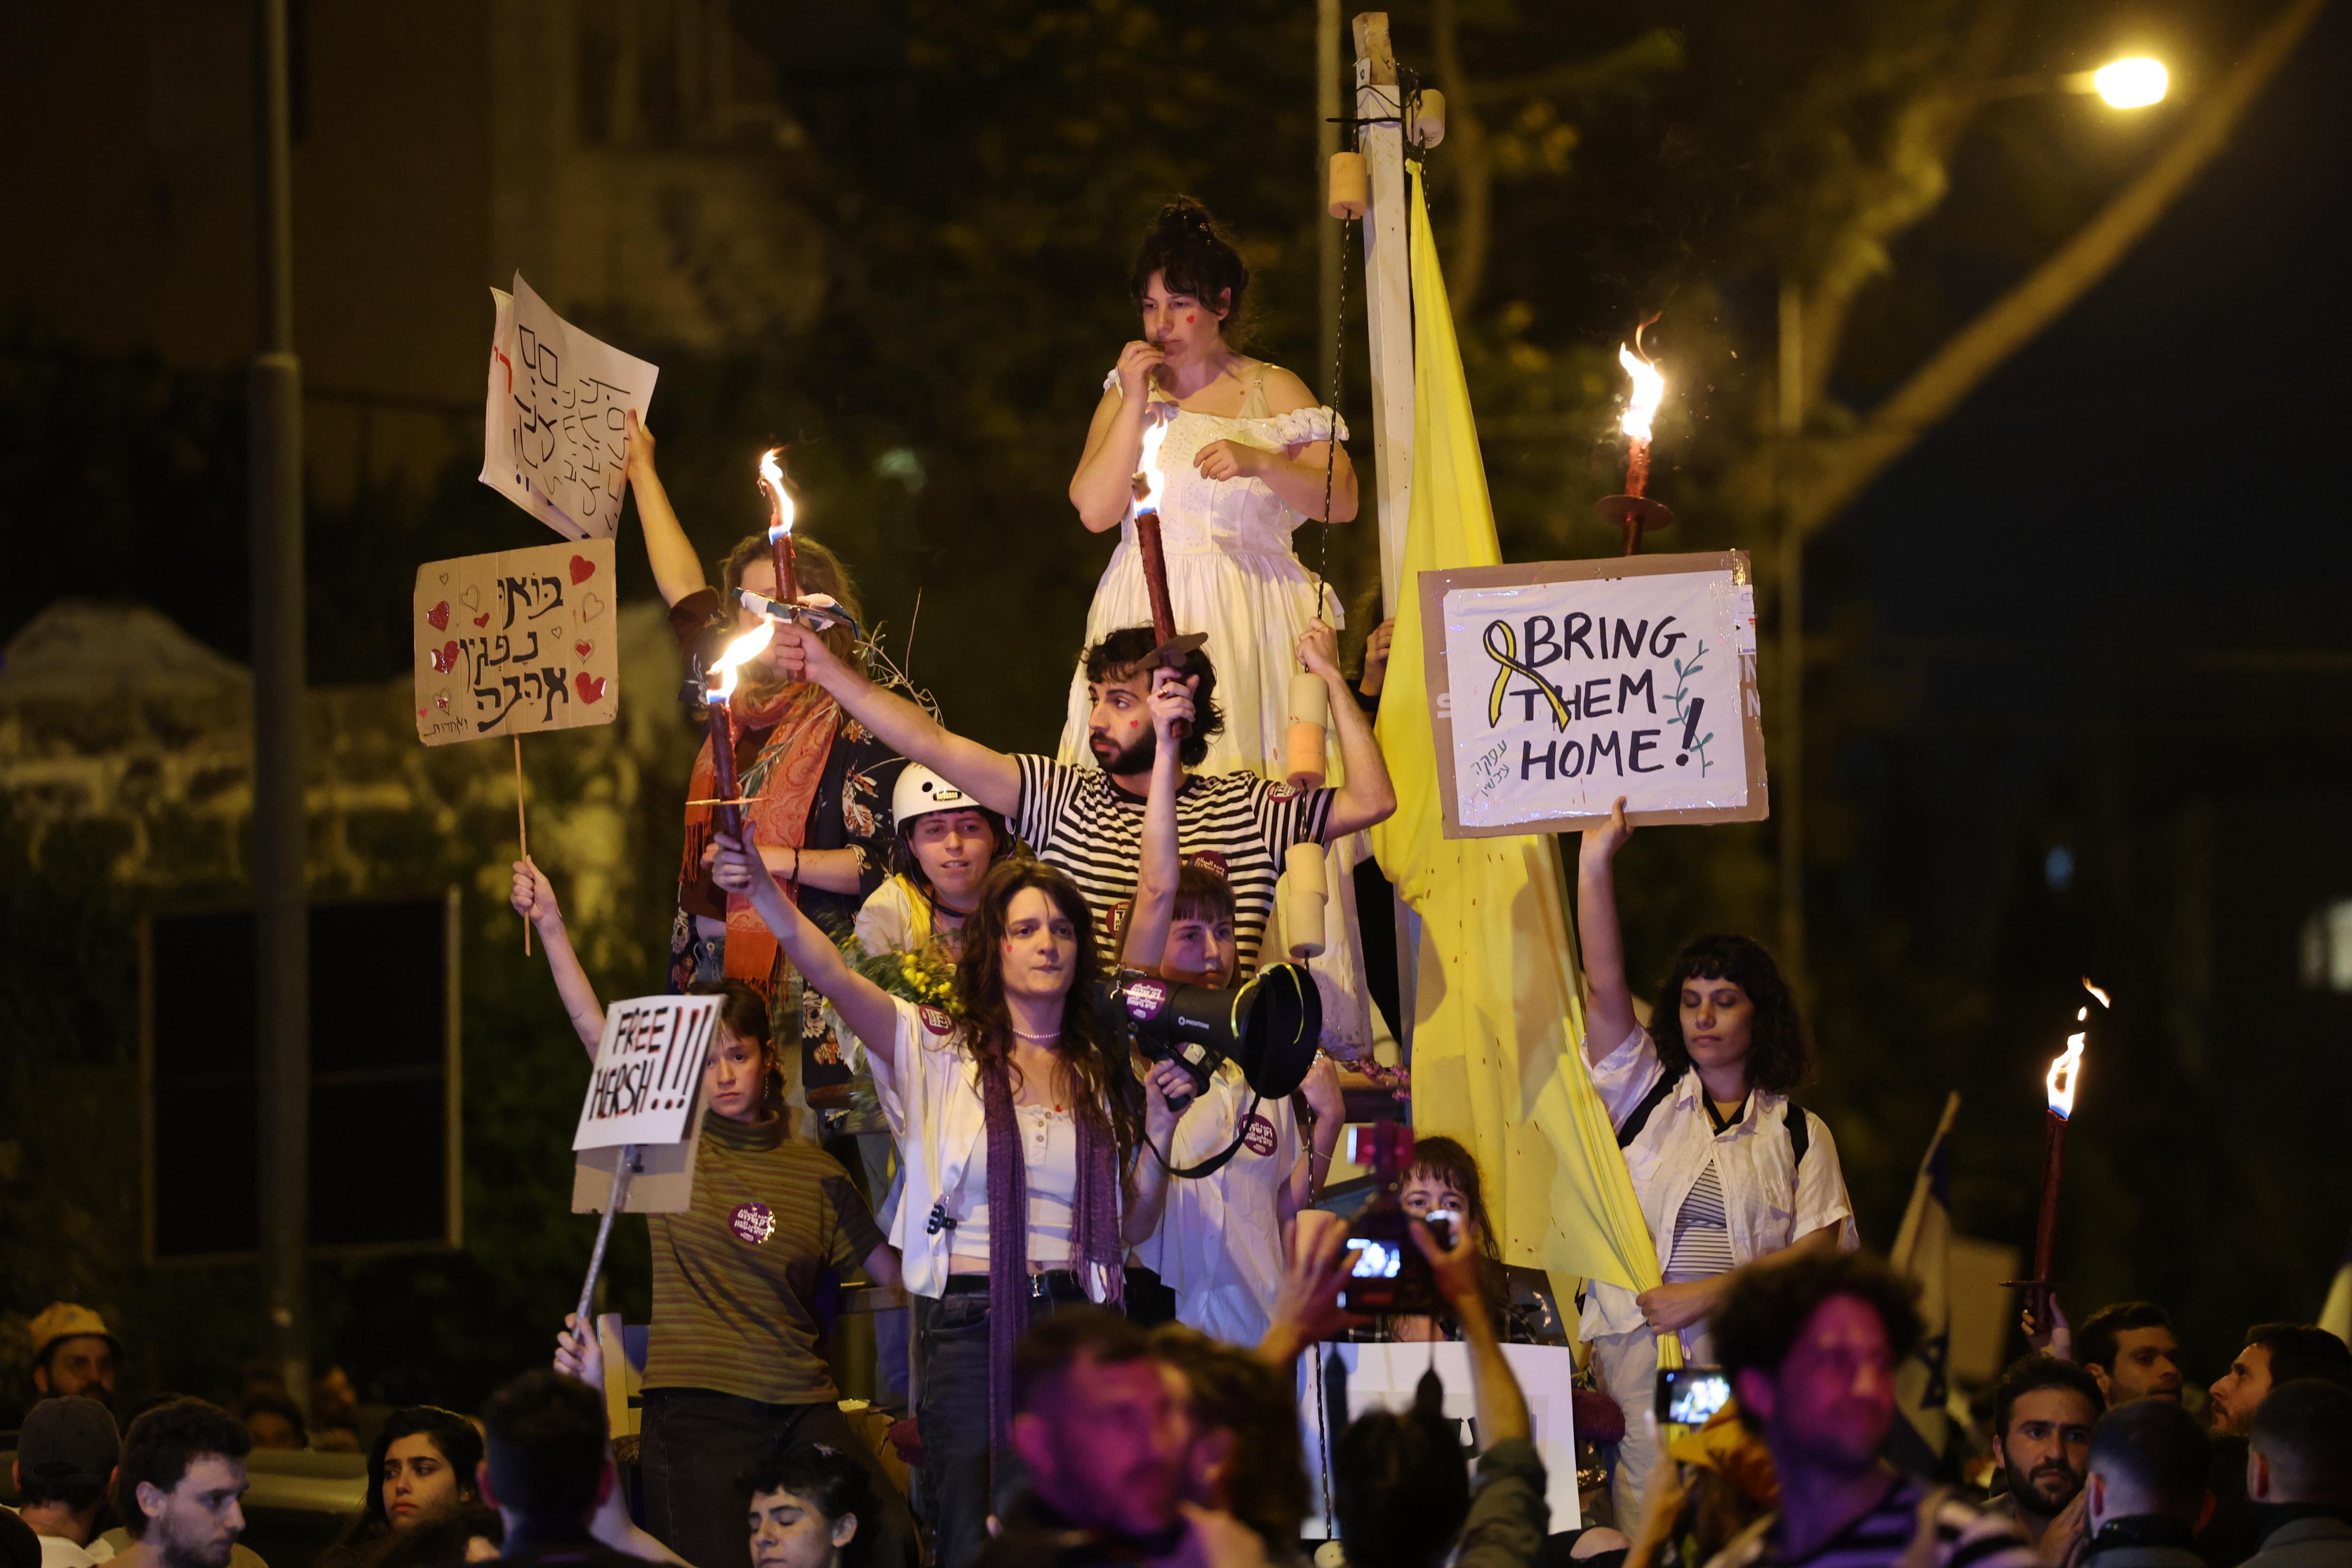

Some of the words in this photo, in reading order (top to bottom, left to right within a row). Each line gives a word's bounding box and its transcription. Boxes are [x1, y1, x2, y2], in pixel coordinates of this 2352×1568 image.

[1524, 612, 1687, 668] BRING
[1509, 669, 1657, 723] THEM
[1470, 740, 1507, 776] עסקה
[612, 1006, 669, 1055] FREE
